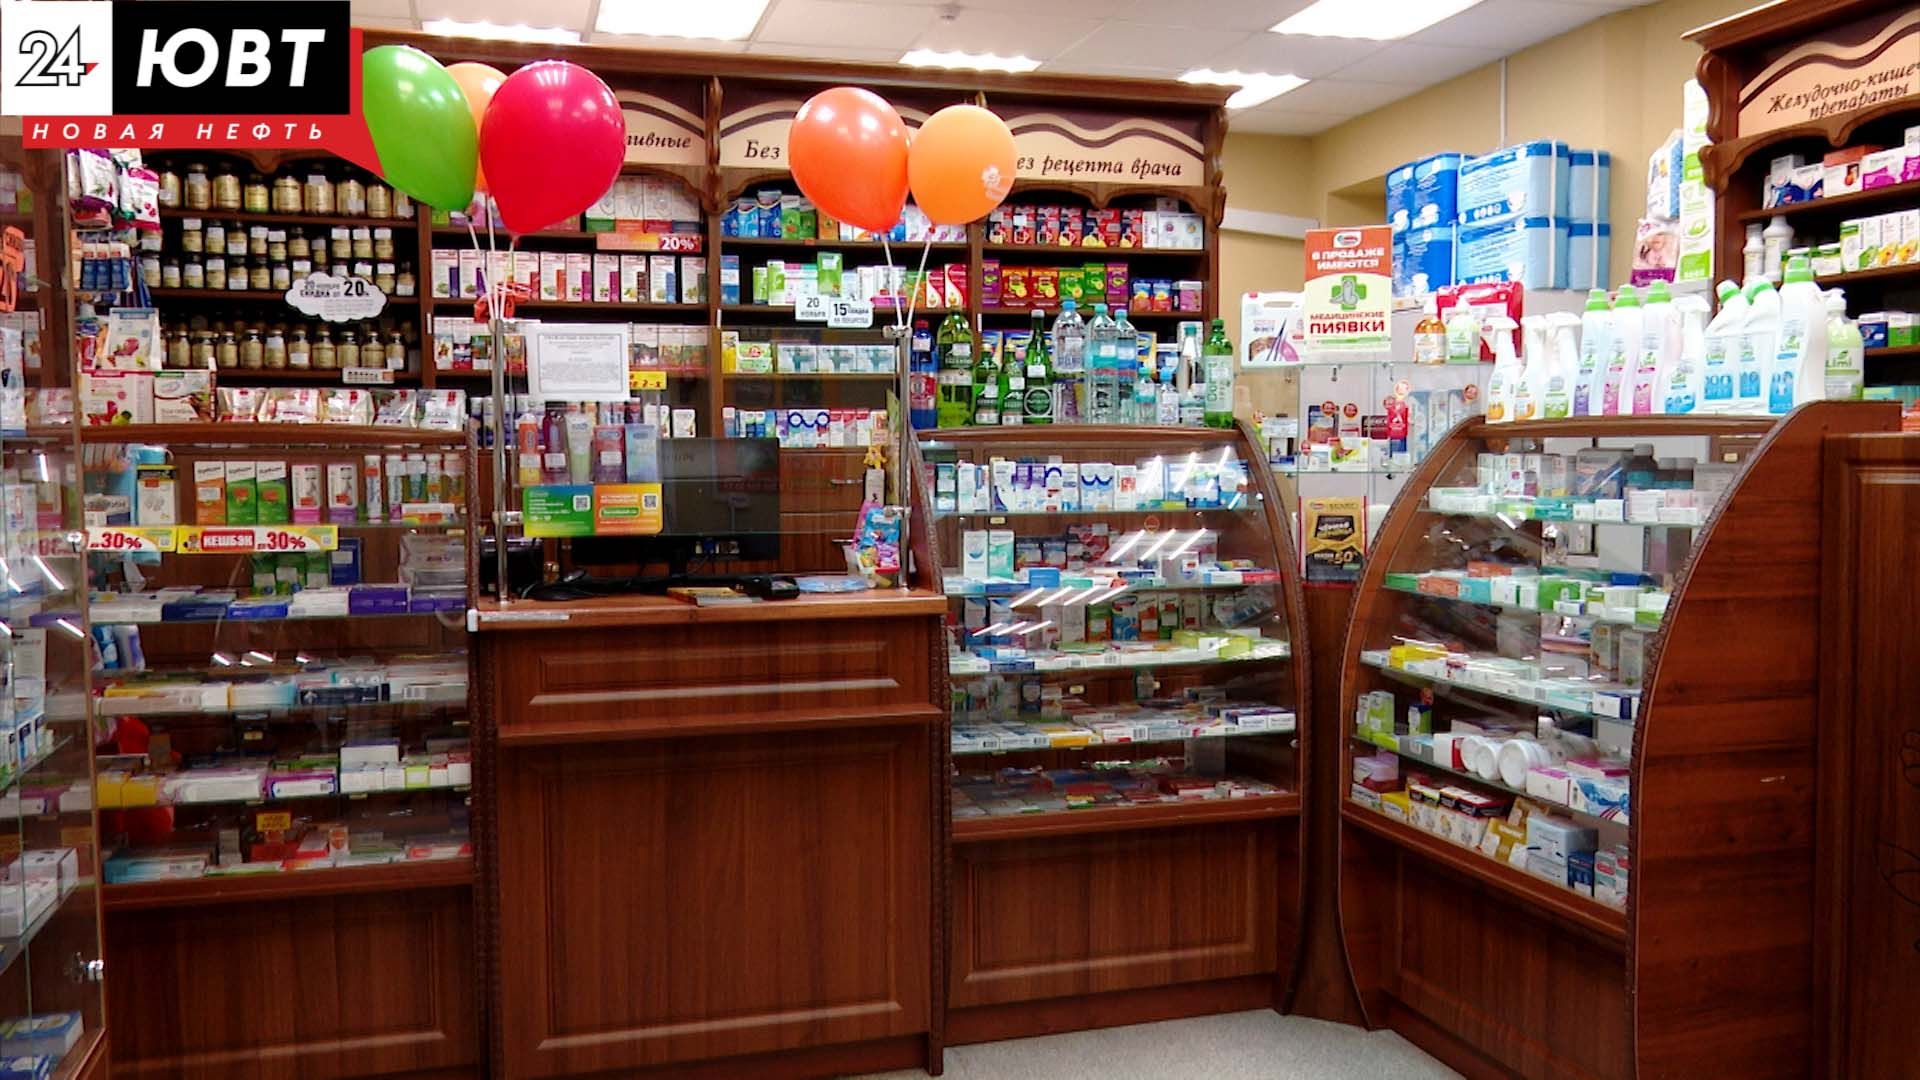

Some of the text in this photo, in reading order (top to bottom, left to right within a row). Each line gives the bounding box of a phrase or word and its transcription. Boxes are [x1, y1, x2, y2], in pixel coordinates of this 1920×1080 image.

[1809, 83, 1910, 119] препараты
[744, 139, 781, 160] Без
[1041, 155, 1123, 176] рецепта
[1130, 158, 1182, 180] врача
[1322, 247, 1385, 260] ПРОДАЖЕ
[1317, 258, 1379, 271] ИМЕЮТСЯ
[806, 297, 820, 308] 20
[1310, 311, 1385, 320] МЕДИЦИНСКИЕ
[1310, 320, 1385, 334] ПИЯВКИ
[1825, 357, 1853, 368] Limi
[101, 532, 143, 549] 30%
[266, 531, 307, 550] 30%
